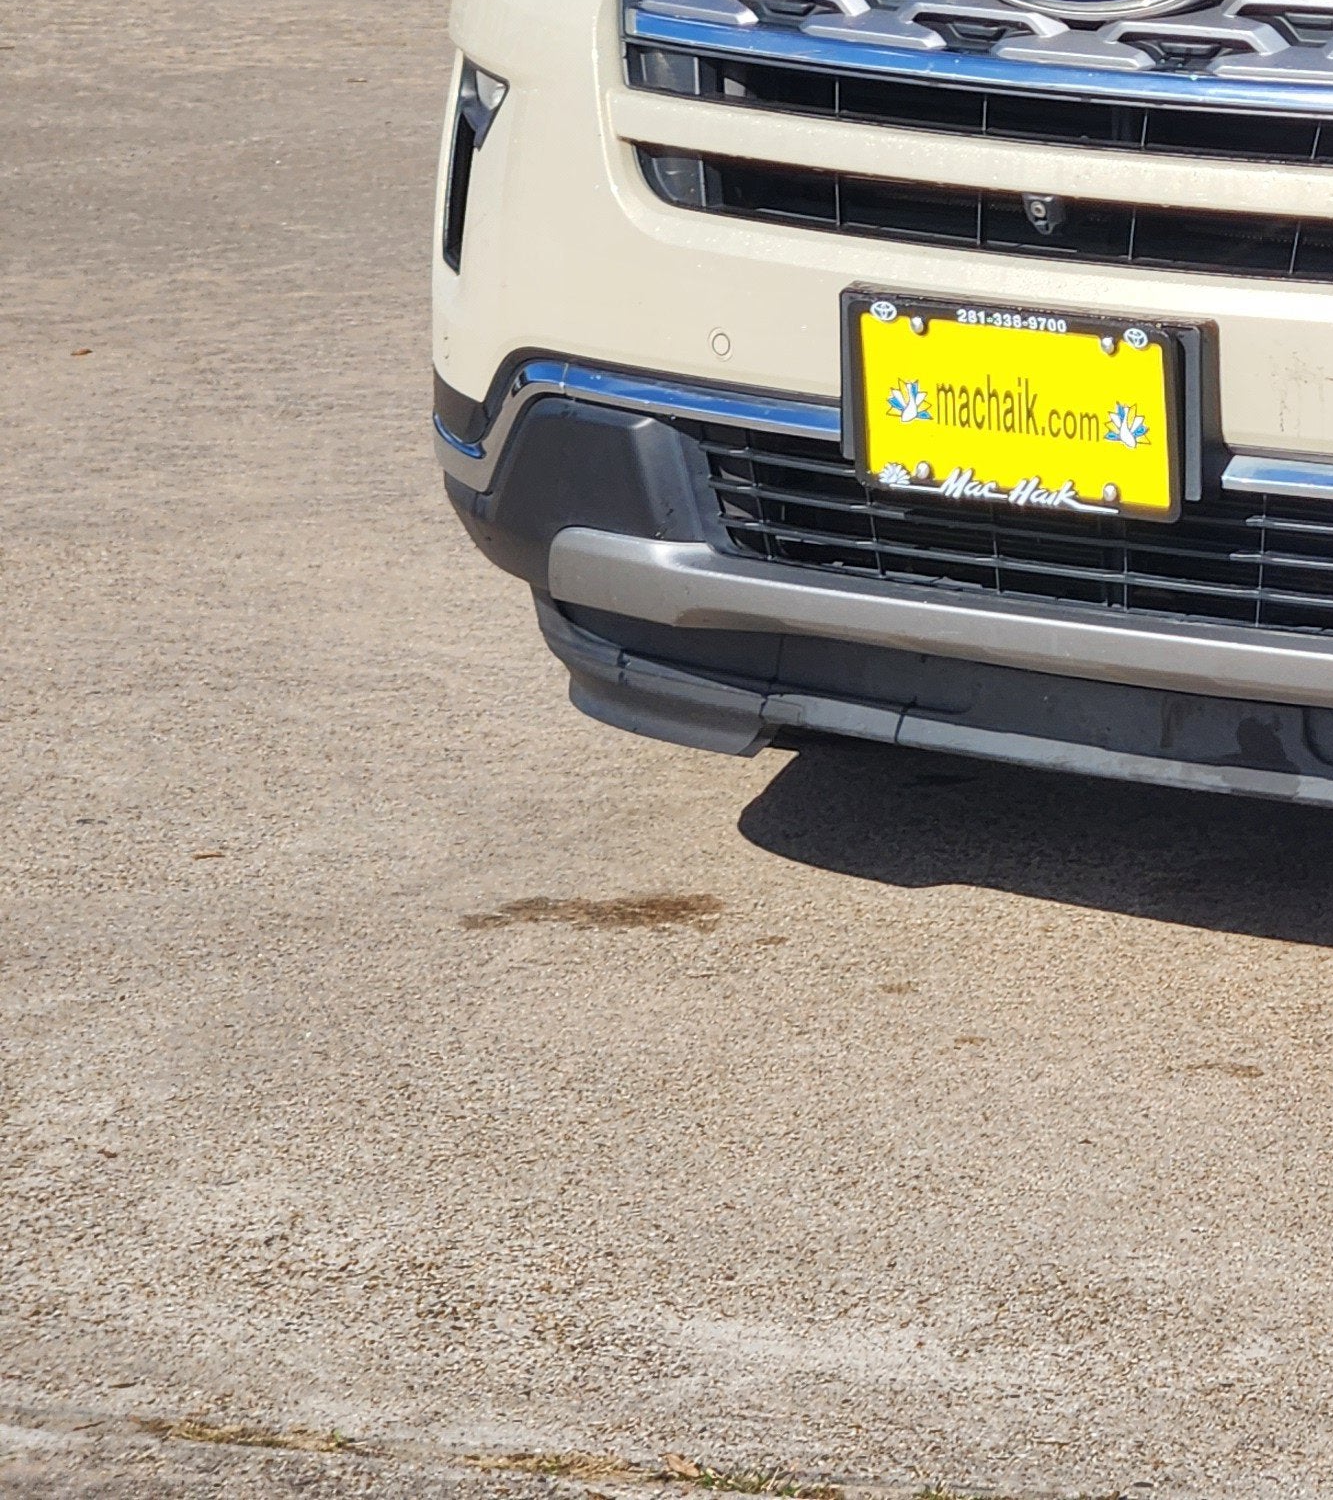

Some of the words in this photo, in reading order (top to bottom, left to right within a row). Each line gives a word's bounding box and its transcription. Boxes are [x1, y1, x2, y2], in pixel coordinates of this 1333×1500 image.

[955, 307, 1068, 333] 281-338-9700
[936, 373, 1100, 443] machaik.com
[941, 467, 1003, 500] Mac
